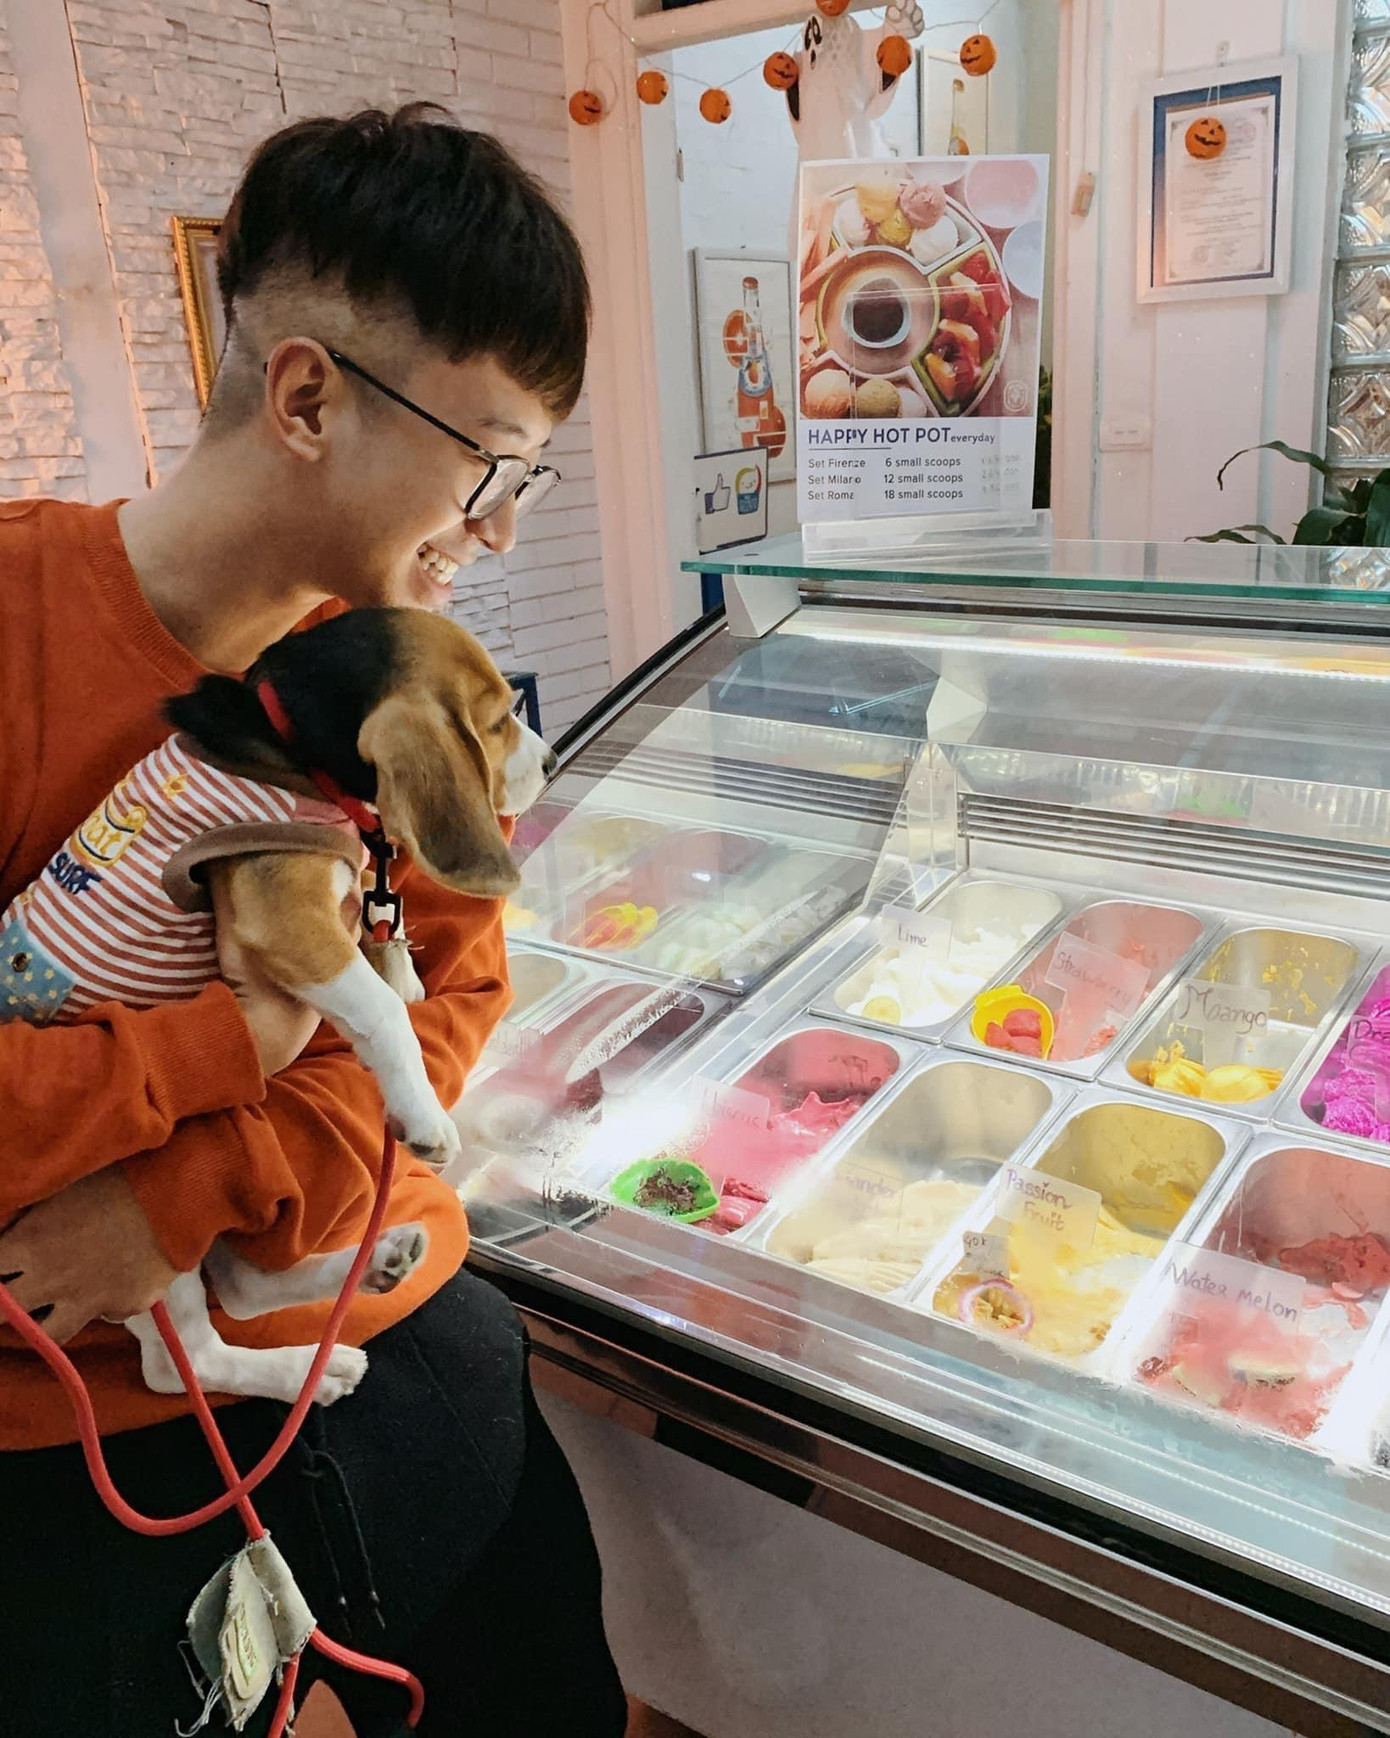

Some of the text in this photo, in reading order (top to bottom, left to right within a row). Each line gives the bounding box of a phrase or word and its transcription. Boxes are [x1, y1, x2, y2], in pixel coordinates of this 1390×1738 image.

[808, 427, 995, 445] HAPPY HOT POT everyday
[808, 458, 825, 468] Set
[885, 457, 892, 467] 6
[895, 457, 921, 467] small
[924, 458, 961, 468] scoops
[808, 475, 825, 484] Set
[884, 473, 895, 483] 12
[897, 473, 924, 483] small
[927, 474, 963, 484] scoops
[808, 490, 825, 500] Set
[884, 489, 895, 499] 18
[898, 489, 924, 499] small
[927, 490, 963, 500] scoops
[897, 922, 928, 948] Lime
[1006, 1168, 1072, 1210] Passion
